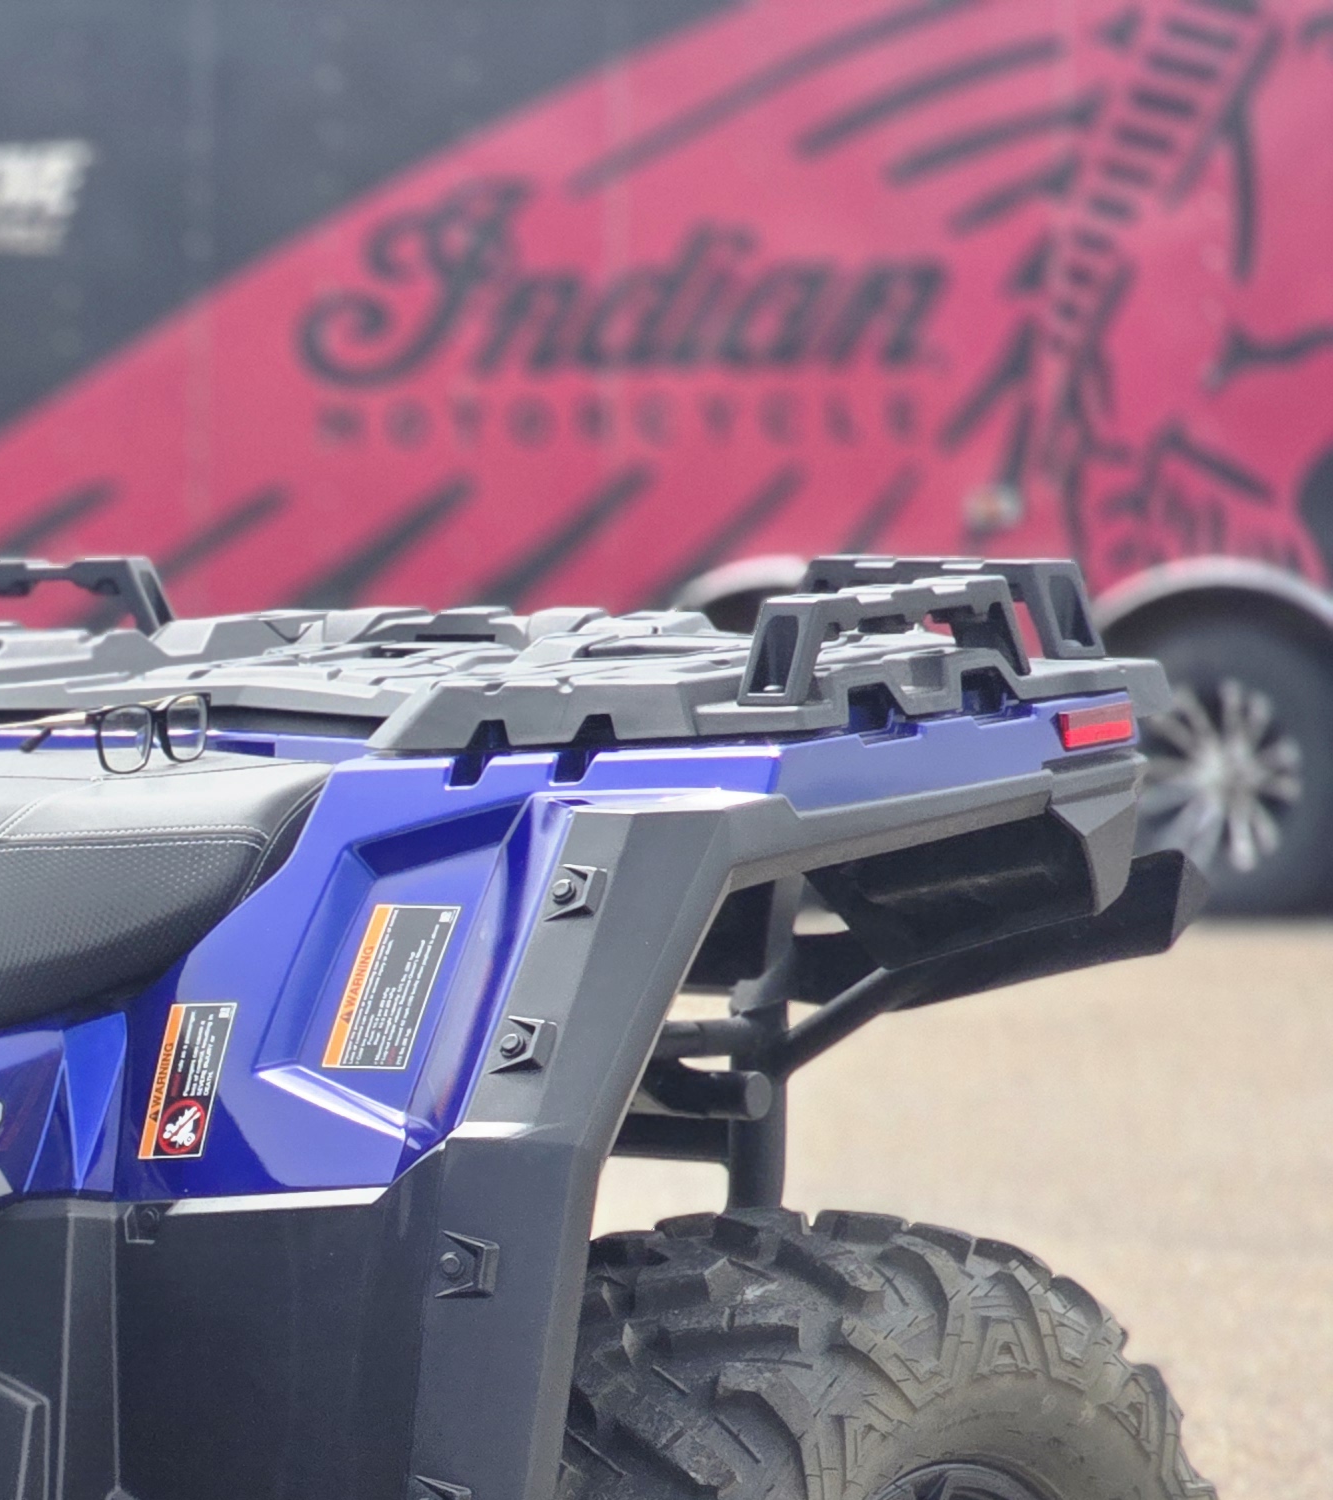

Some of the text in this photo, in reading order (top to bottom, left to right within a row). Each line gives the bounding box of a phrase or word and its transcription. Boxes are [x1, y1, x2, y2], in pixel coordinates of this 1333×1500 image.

[295, 174, 947, 392] Indian
[343, 945, 375, 1011] WARNING
[151, 1042, 174, 1107] WARNING
